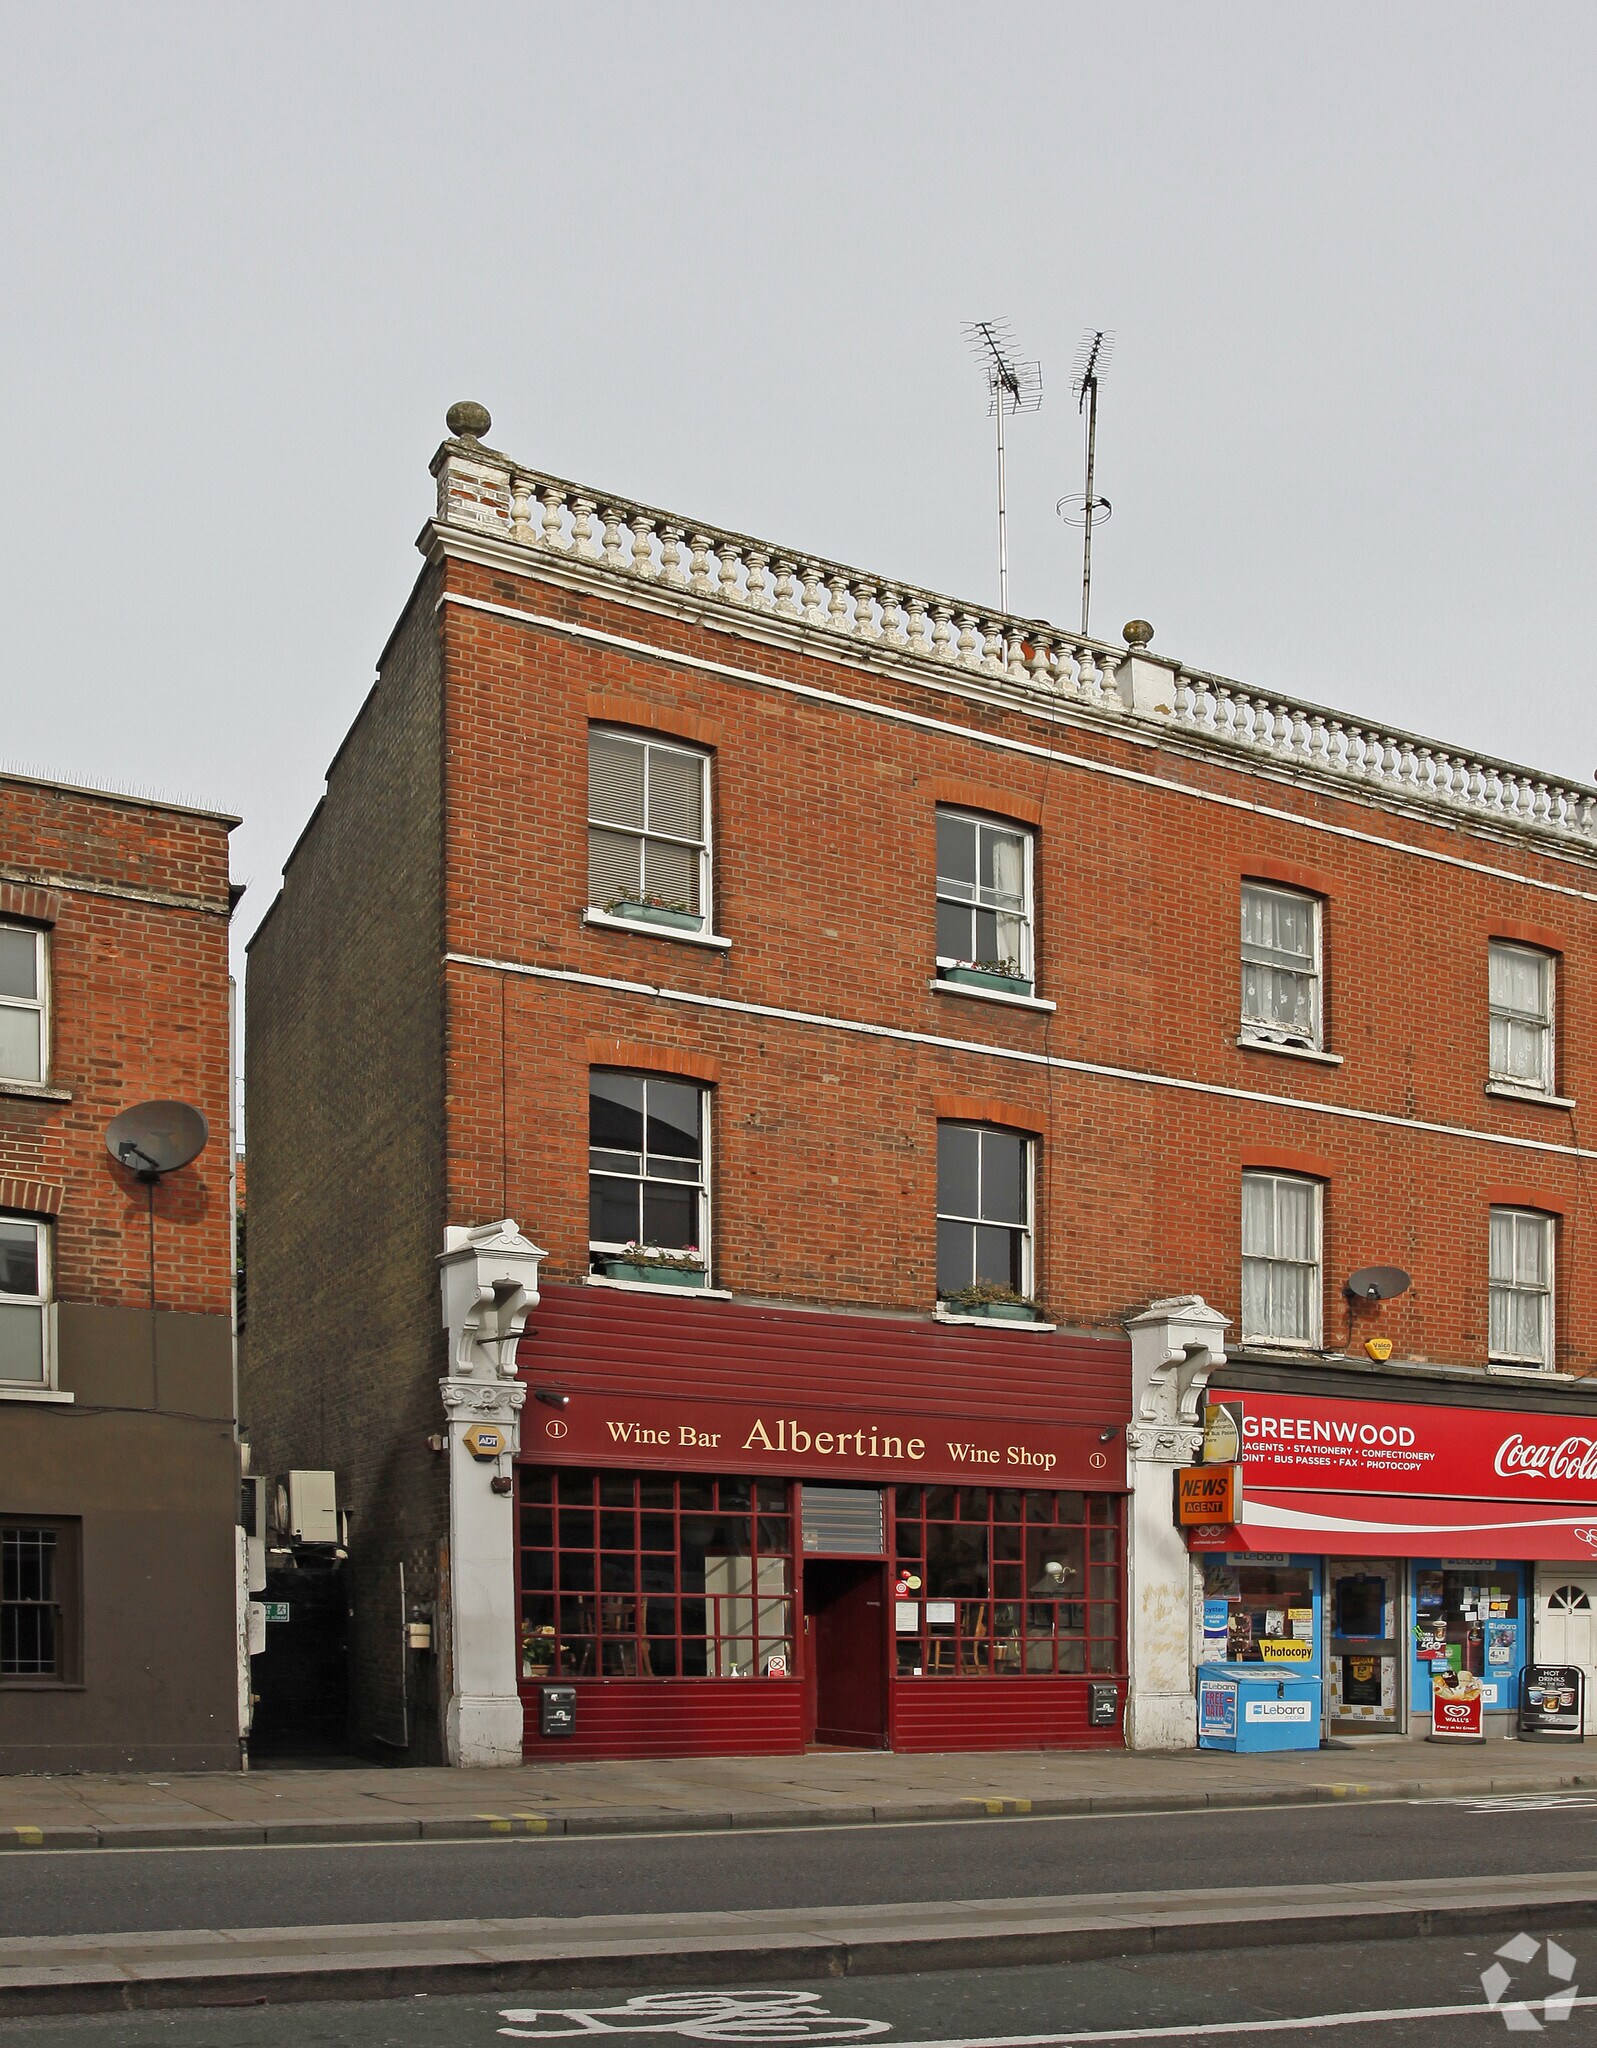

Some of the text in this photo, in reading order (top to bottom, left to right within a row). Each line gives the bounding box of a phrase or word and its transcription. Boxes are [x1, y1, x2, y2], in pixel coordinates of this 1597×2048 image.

[606, 1421, 721, 1448] Wine Bar
[1242, 1416, 1416, 1447] GREENWOOD
[479, 1436, 497, 1446] ADT
[742, 1418, 927, 1461] Albertine
[946, 1442, 1057, 1471] Wine Shop
[1293, 1445, 1353, 1456] STATIONERY
[1361, 1449, 1435, 1461] CONFECTIONERY
[1274, 1456, 1294, 1464] BUS
[1296, 1457, 1331, 1466] PASSES
[1339, 1459, 1358, 1467] FAX
[1366, 1461, 1422, 1471] PHOTOCOPY
[1181, 1478, 1228, 1497] NEWS
[1186, 1502, 1221, 1512] AGENT
[1264, 1646, 1312, 1658] Photocopy
[1208, 1682, 1236, 1690] Lebara
[1206, 1691, 1224, 1704] FREE
[1206, 1704, 1224, 1717] DATA
[1263, 1705, 1305, 1715] Lebara
